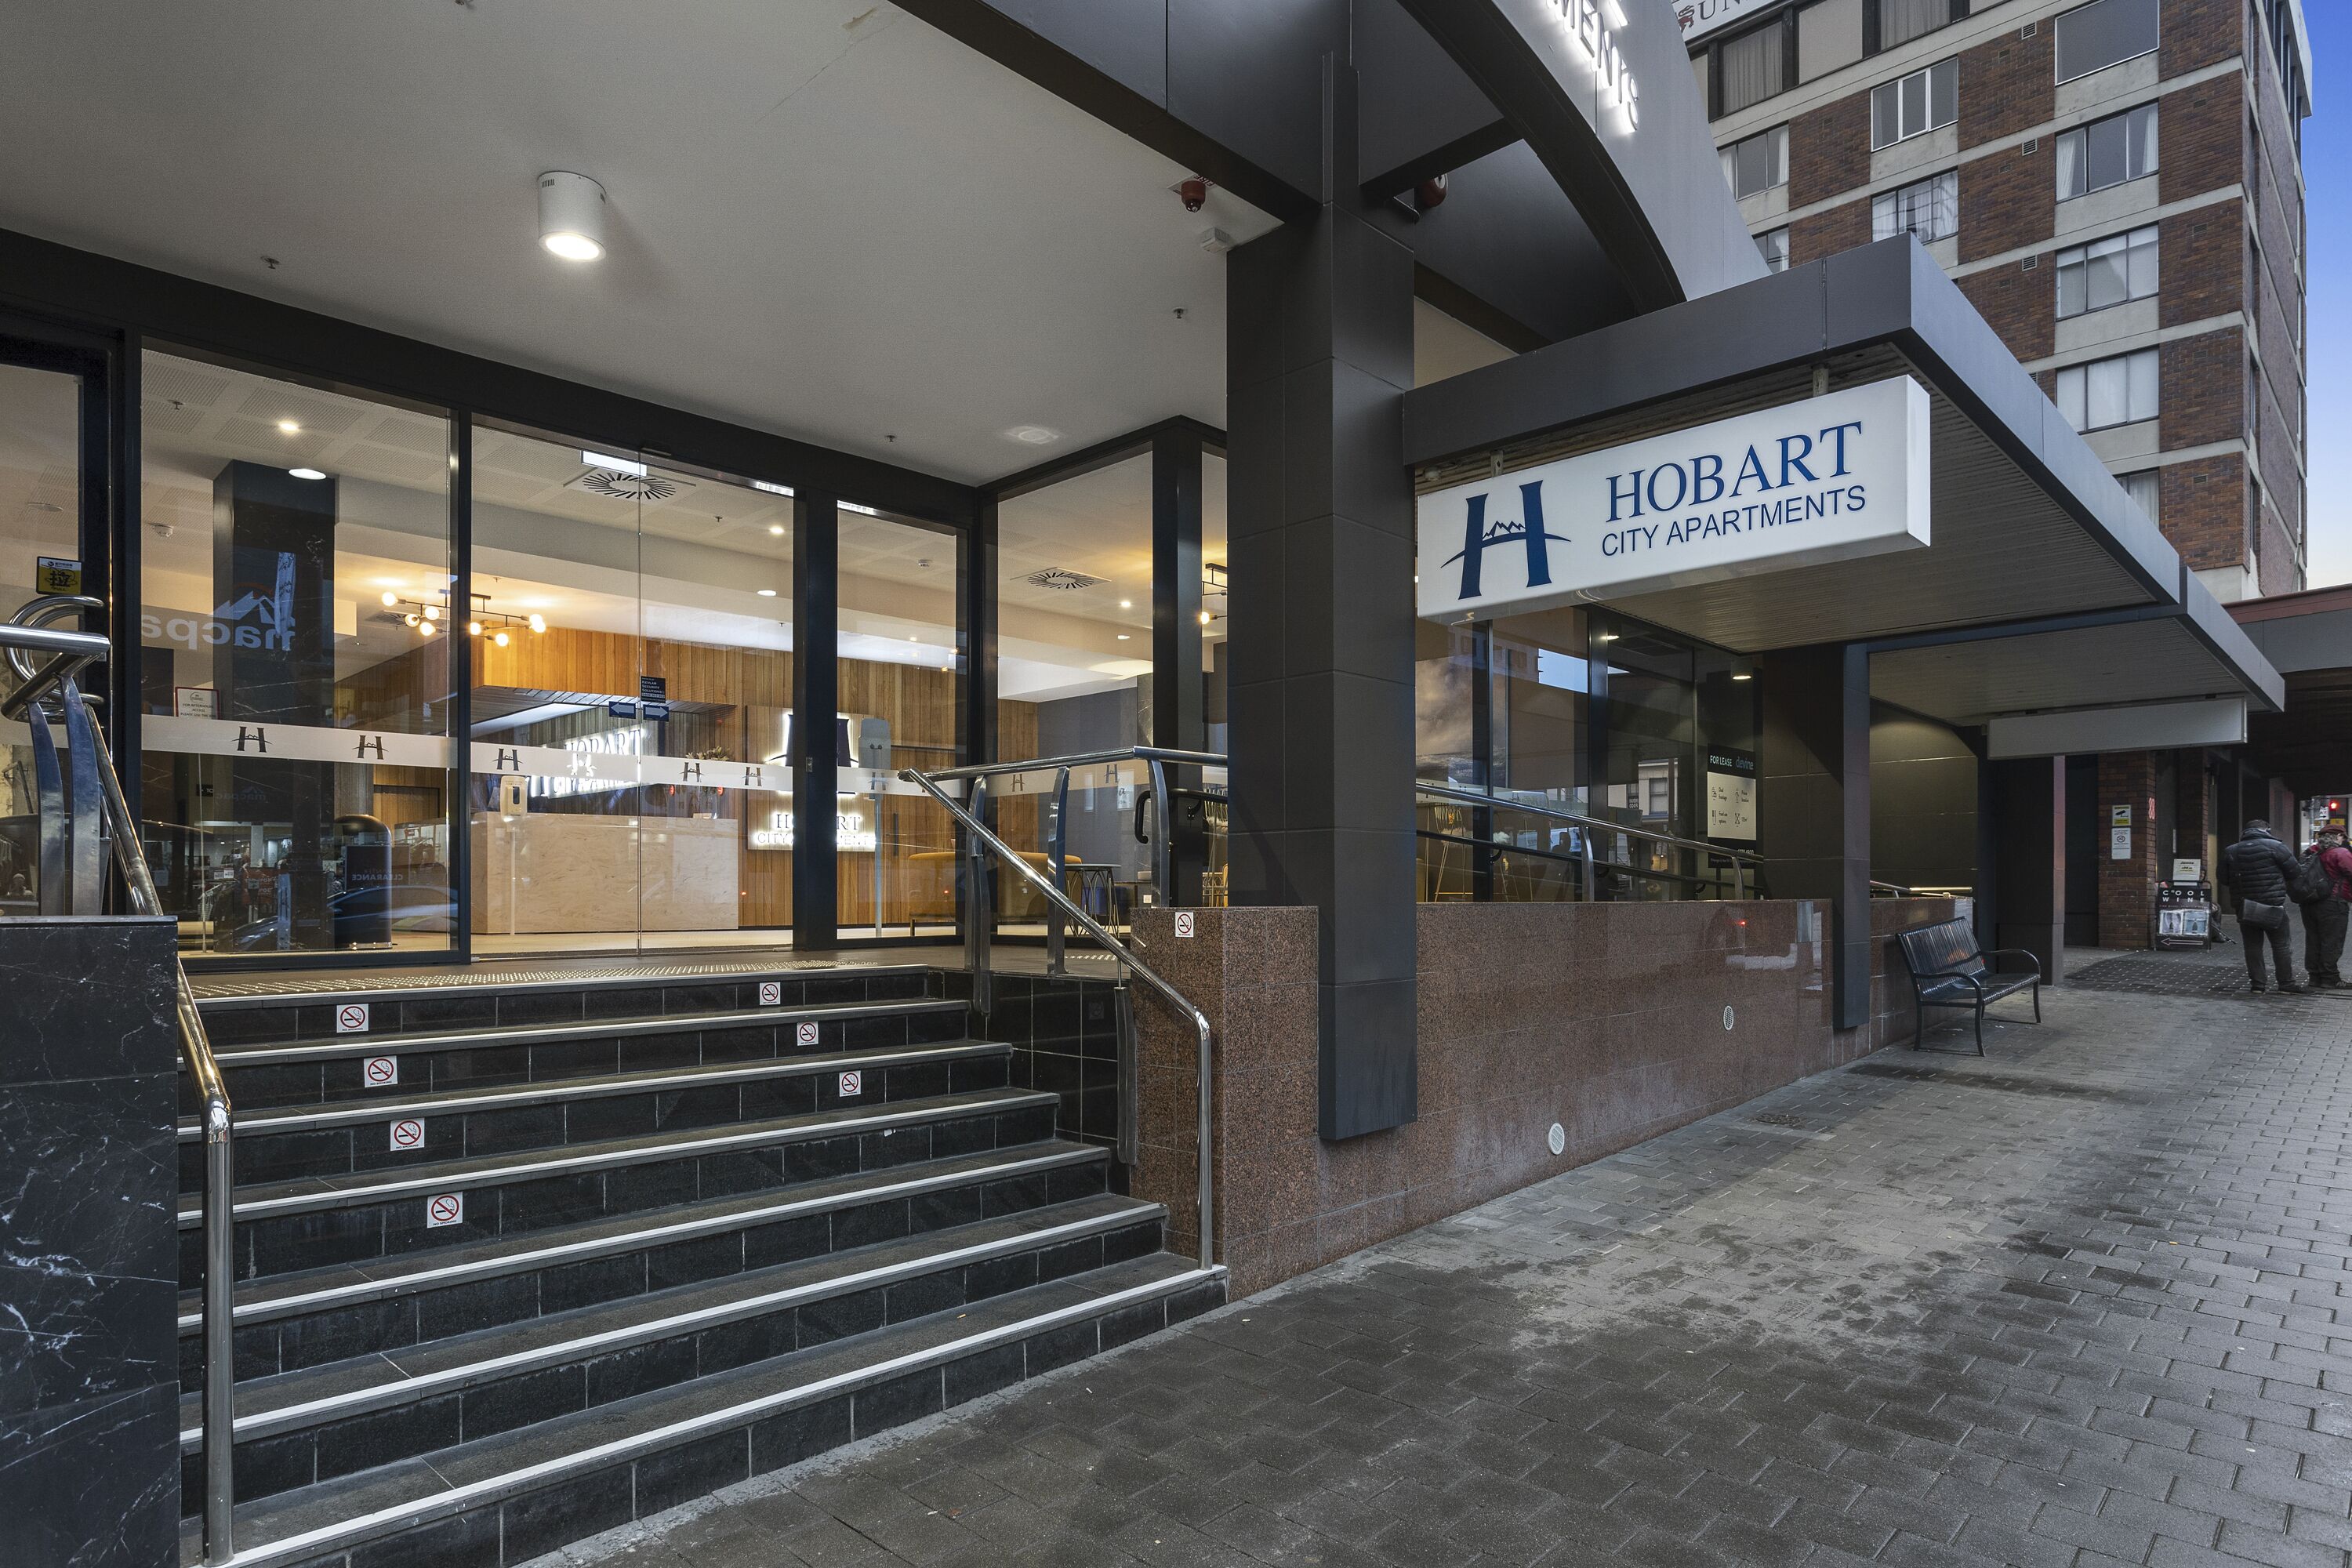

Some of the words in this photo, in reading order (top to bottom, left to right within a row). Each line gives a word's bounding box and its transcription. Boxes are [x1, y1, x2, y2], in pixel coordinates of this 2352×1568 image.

[1605, 421, 1863, 523] HOBART
[1602, 524, 1660, 557] CITY
[1667, 485, 1866, 546] APARTMENTS
[1710, 755, 1719, 764] FOR
[1719, 757, 1733, 767] LEASE
[757, 833, 789, 844] CITY
